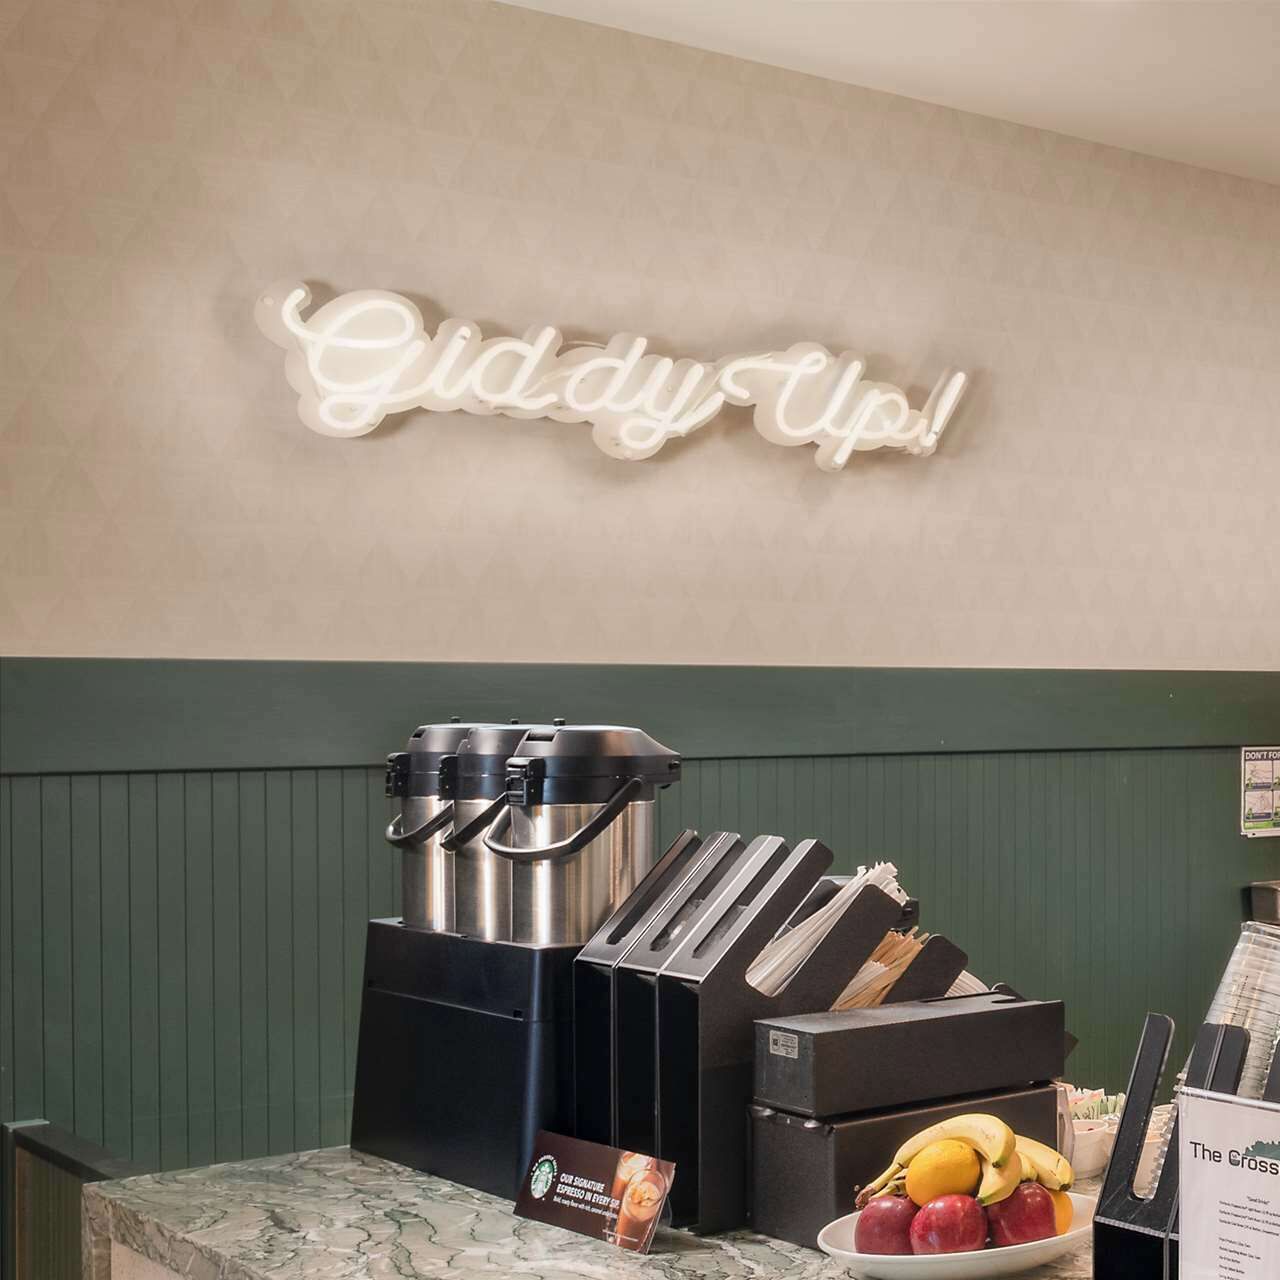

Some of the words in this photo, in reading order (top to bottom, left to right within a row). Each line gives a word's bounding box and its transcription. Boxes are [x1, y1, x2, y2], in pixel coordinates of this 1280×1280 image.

[282, 288, 727, 450] Giddy
[722, 350, 966, 468] Up!
[1245, 752, 1267, 760] DON'T
[1189, 1141, 1222, 1163] The
[560, 1172, 572, 1185] OUR
[573, 1176, 605, 1193] SIGNATURE
[556, 1183, 585, 1199] ESPRESSO
[585, 1191, 593, 1200] IN
[592, 1193, 611, 1206] EVERY
